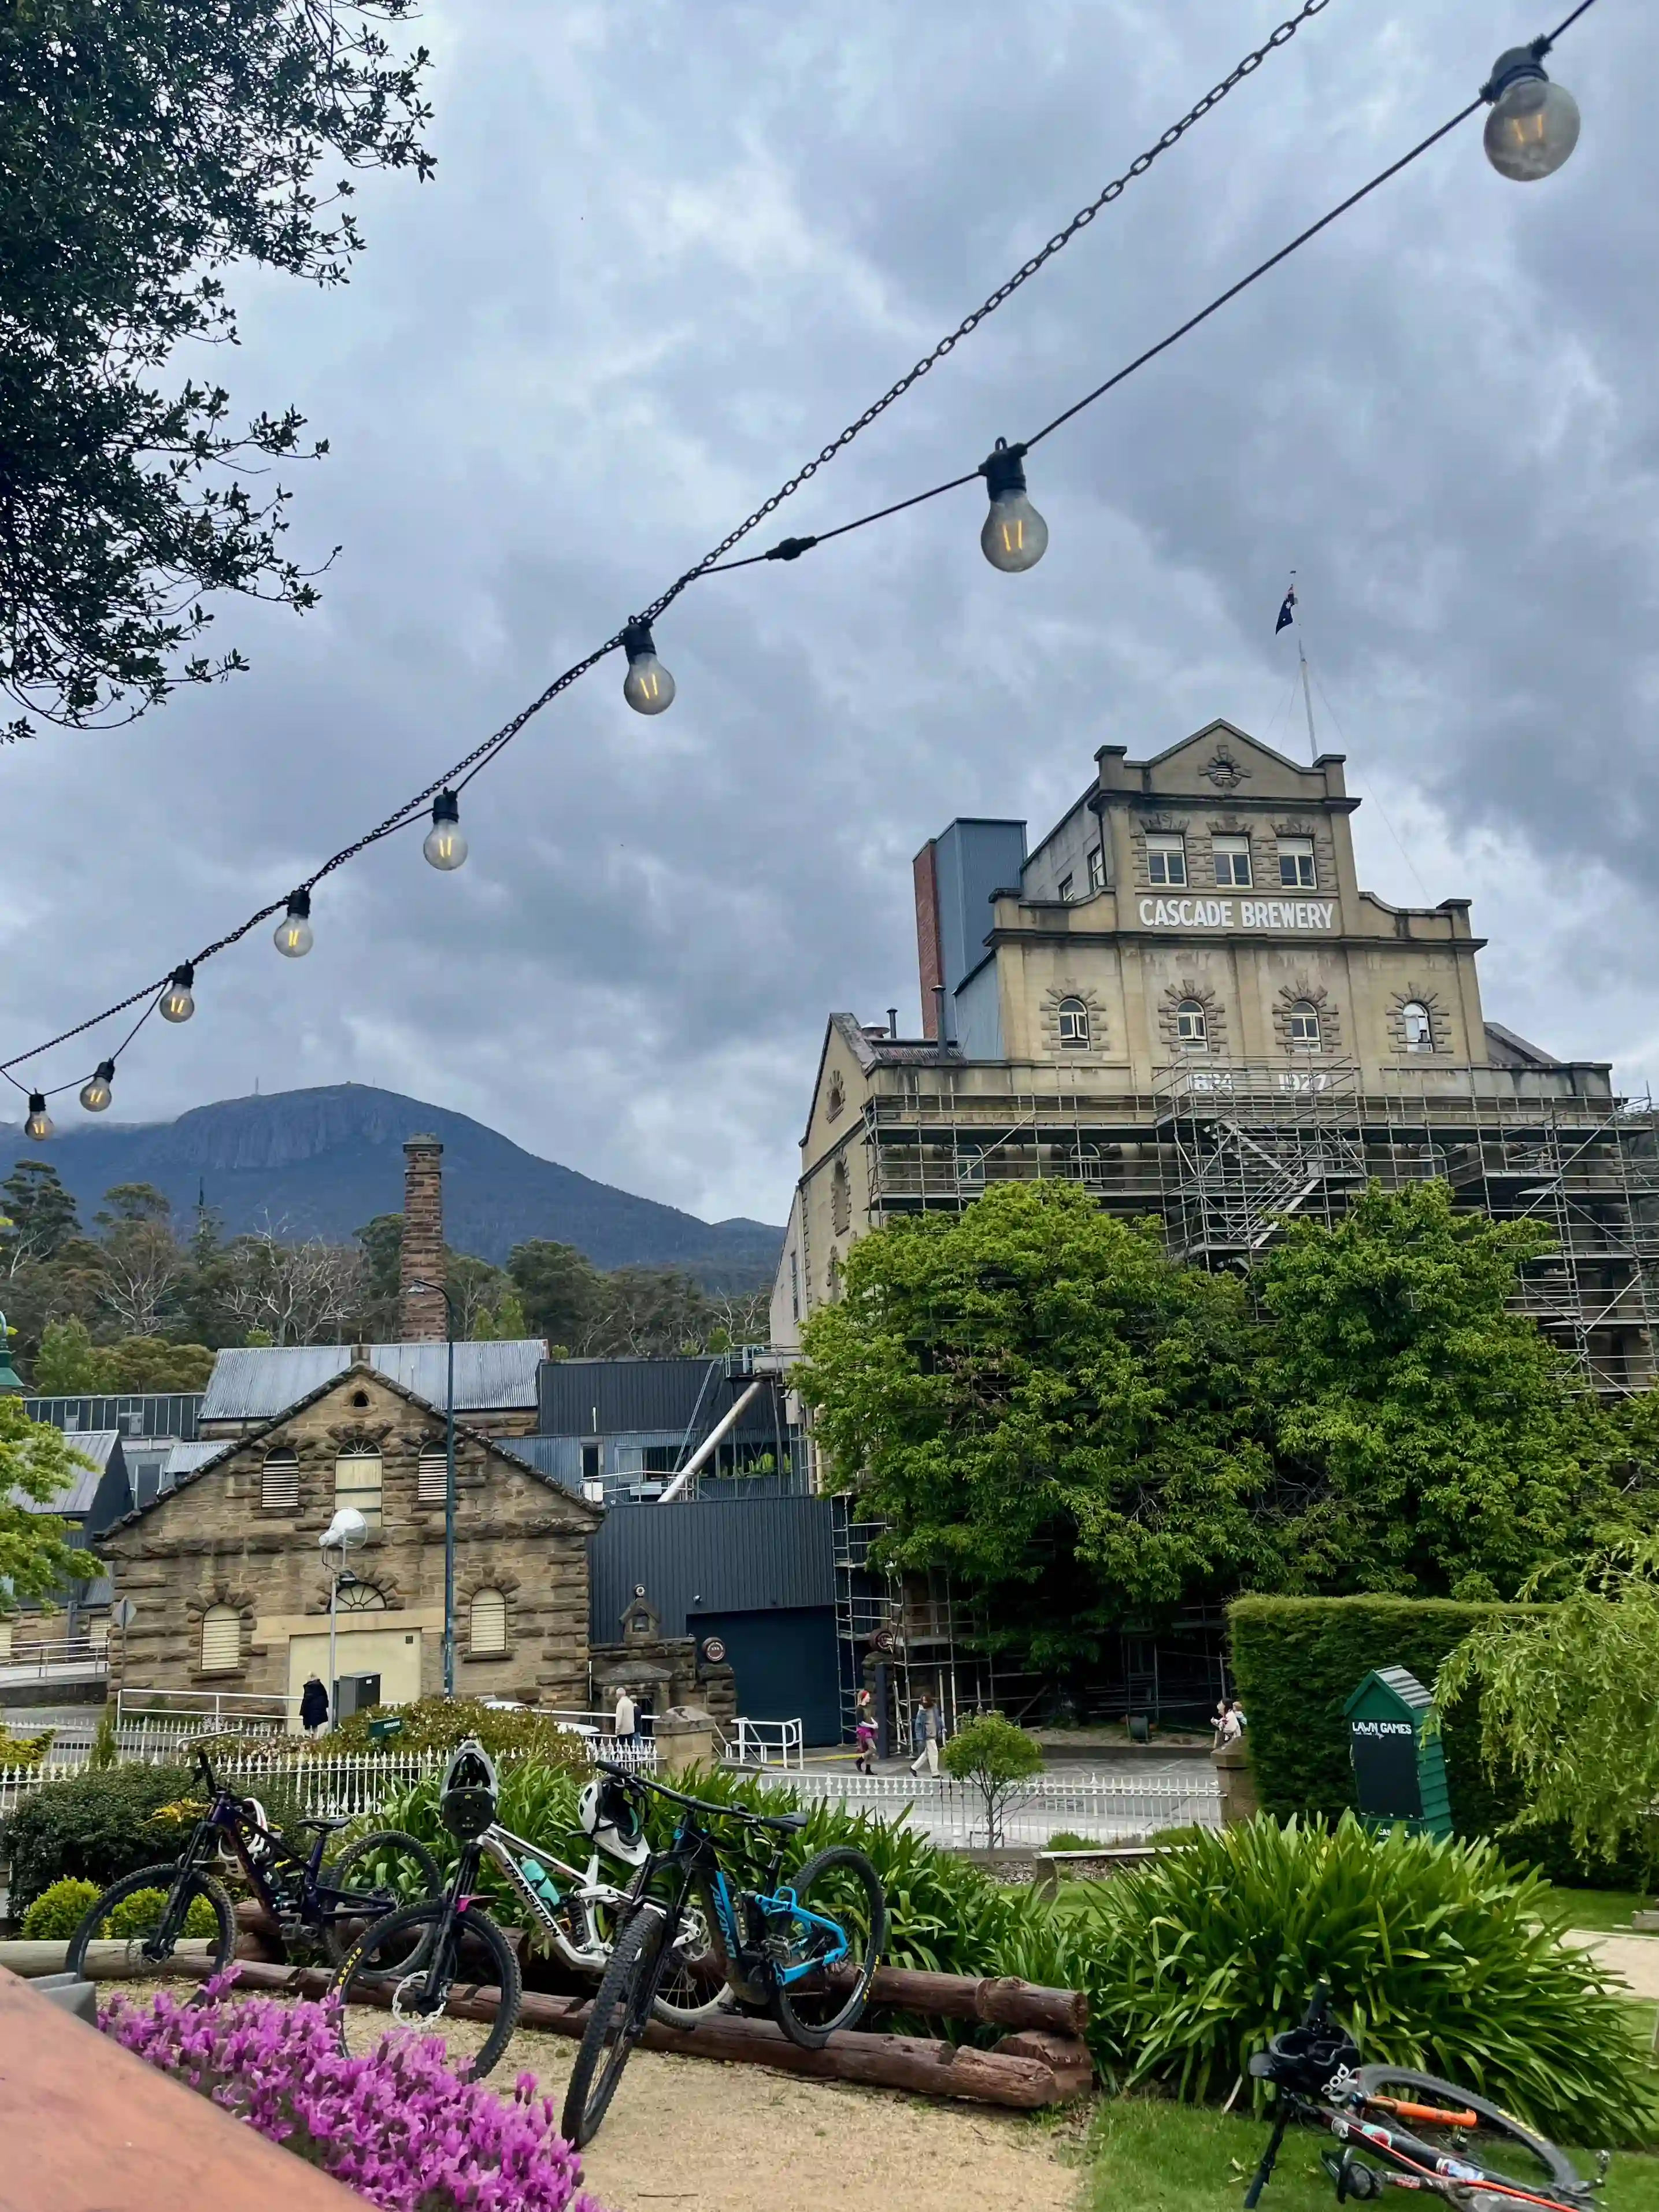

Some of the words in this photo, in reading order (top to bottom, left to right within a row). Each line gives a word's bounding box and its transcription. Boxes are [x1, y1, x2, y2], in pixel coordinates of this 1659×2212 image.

[1139, 899, 1234, 927] CASCADE
[1241, 901, 1333, 929] BREWERY
[1352, 1722, 1378, 1733] LAWN
[1380, 1722, 1412, 1734] GAMES
[504, 1858, 561, 1938] TRANSITION
